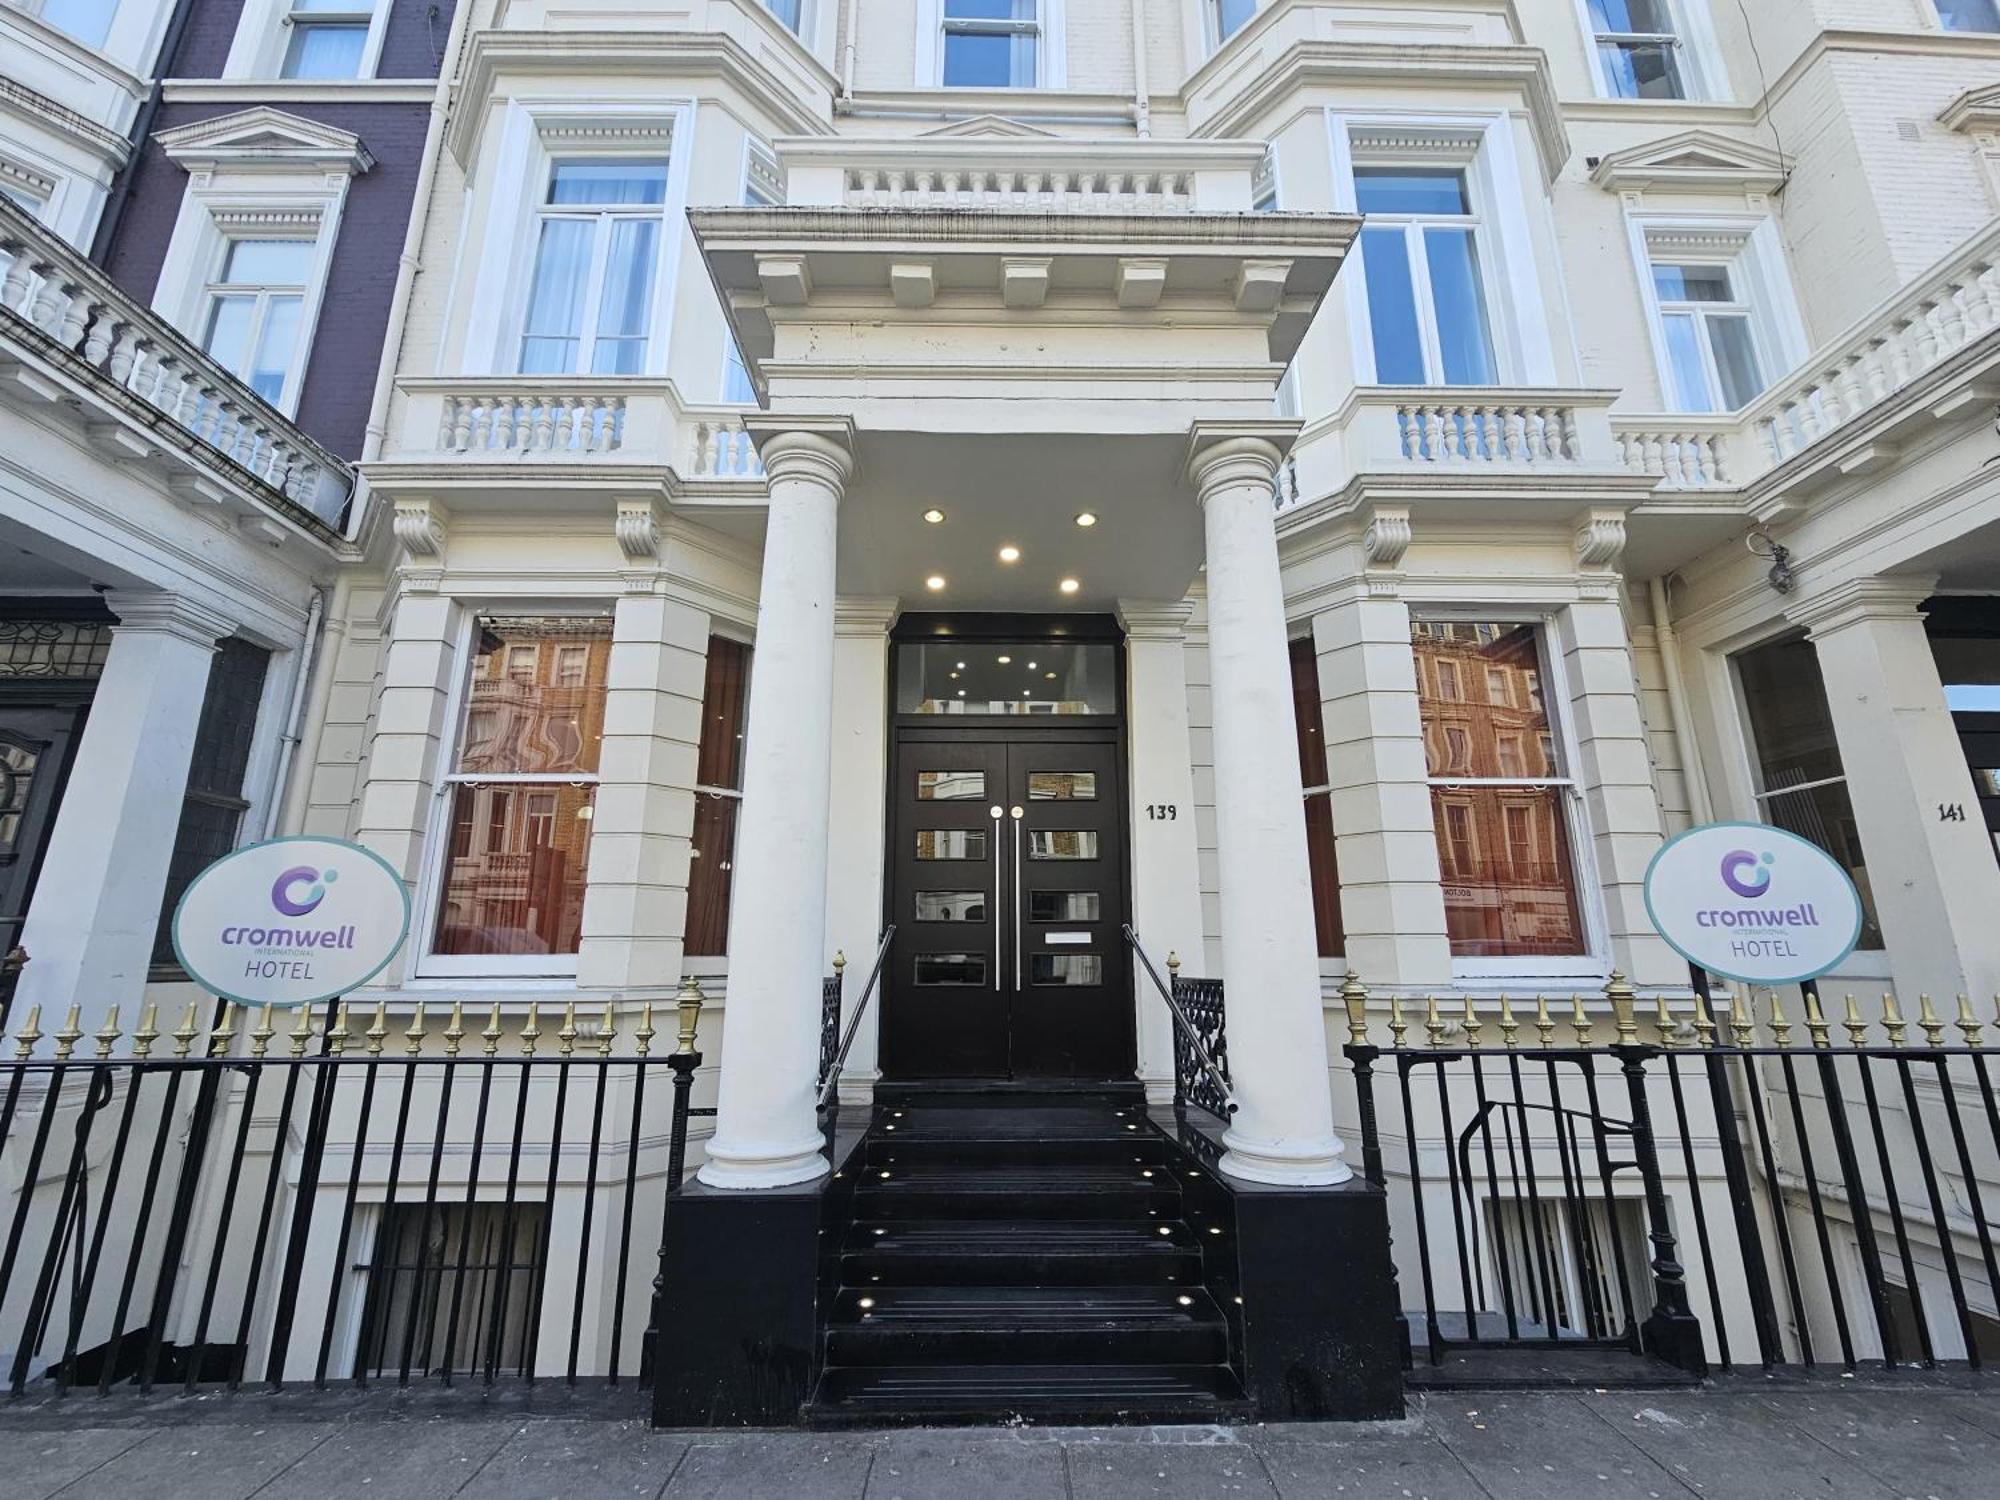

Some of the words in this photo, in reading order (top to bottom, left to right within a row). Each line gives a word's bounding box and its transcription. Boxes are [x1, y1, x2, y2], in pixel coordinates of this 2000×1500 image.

[1146, 804, 1177, 820] 139
[1938, 803, 1966, 822] 141
[1696, 903, 1819, 928] cromwell
[221, 926, 355, 949] cromwell
[254, 948, 314, 957] INTERNATIONAL
[1731, 940, 1798, 957] HOTEL
[245, 960, 315, 980] HOTEL
